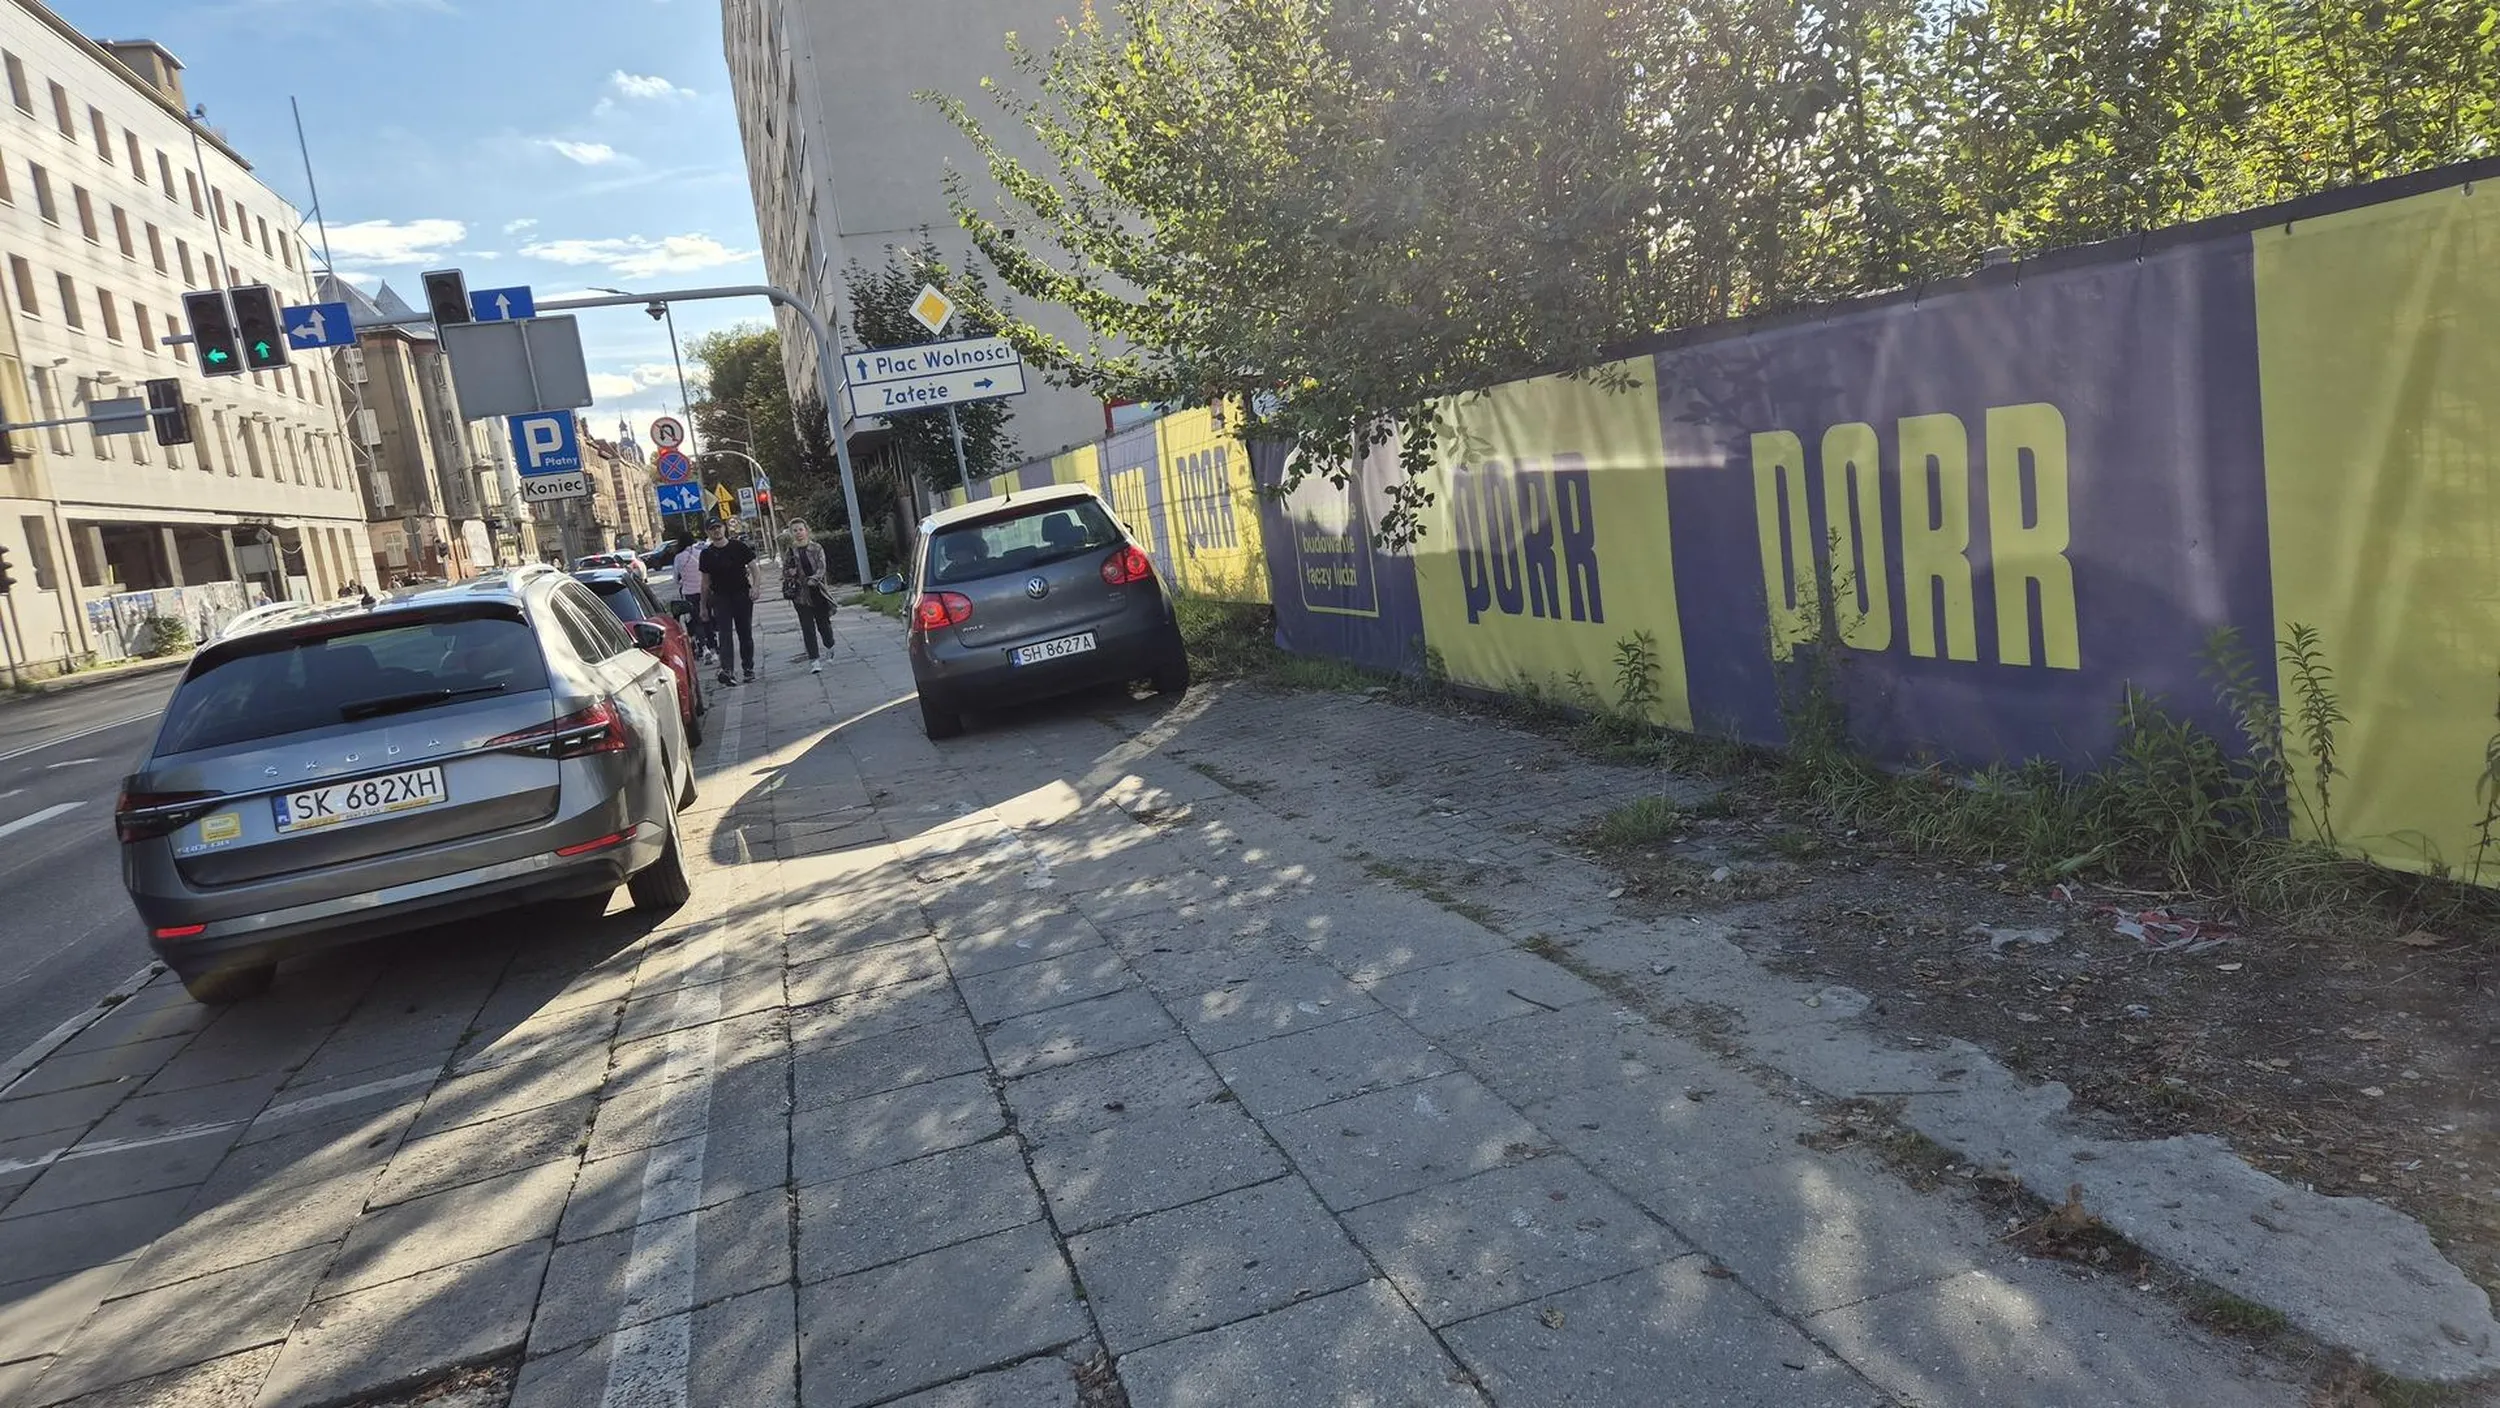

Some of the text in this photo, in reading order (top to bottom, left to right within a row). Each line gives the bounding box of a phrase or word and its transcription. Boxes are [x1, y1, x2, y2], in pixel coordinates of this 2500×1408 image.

[876, 341, 1011, 374] Plac Wolności
[882, 381, 949, 406] Załęże
[522, 417, 563, 468] P
[544, 456, 578, 467] Płatny
[525, 479, 583, 497] Koniec
[1175, 444, 1238, 559] PORR
[1302, 531, 1357, 554] budowanie
[1452, 451, 1605, 625] PORR
[1750, 401, 2081, 670] PORR
[1305, 562, 1358, 591] łączy ludzi
[1021, 645, 1043, 663] SH
[1047, 639, 1092, 658] 8627A
[294, 789, 335, 820] SK
[346, 770, 438, 811] 682XH
